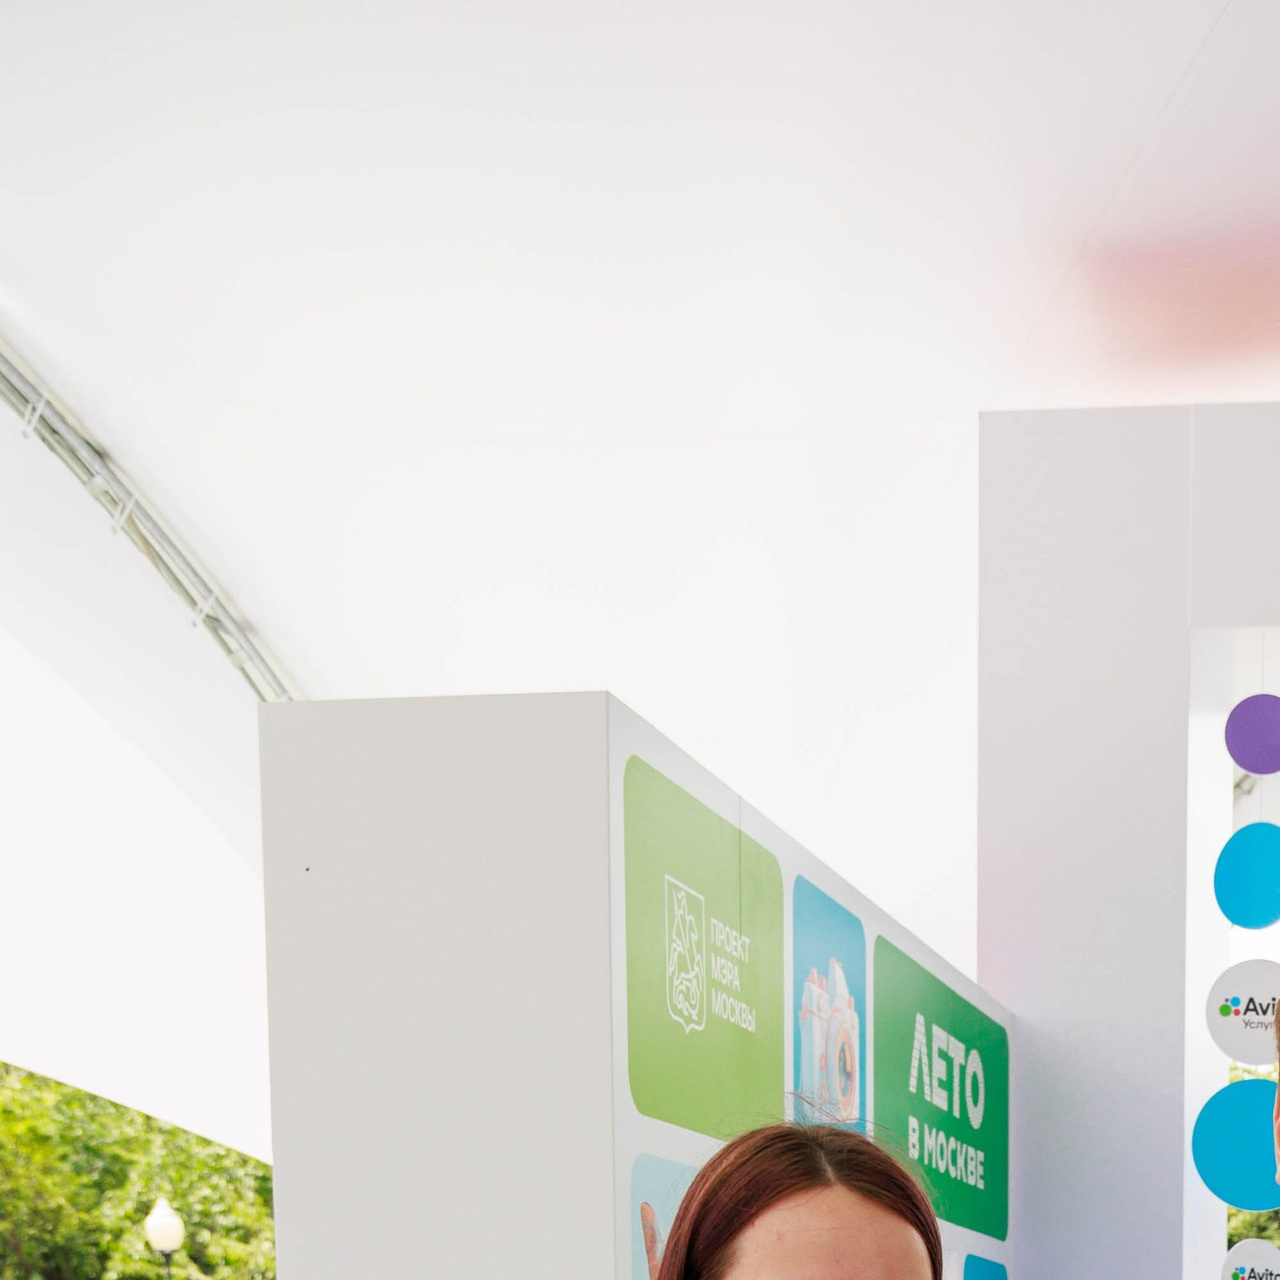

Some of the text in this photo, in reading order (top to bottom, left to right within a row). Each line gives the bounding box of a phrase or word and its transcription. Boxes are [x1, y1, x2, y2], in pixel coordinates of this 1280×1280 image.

[711, 917, 750, 963] ПРОЕКТ
[711, 952, 741, 993] МЭРА
[712, 987, 756, 1034] МОСКВЫ
[1243, 997, 1277, 1016] Avi
[908, 1012, 986, 1130] ЛЕТО
[908, 1115, 986, 1190] В МОСКВЕ
